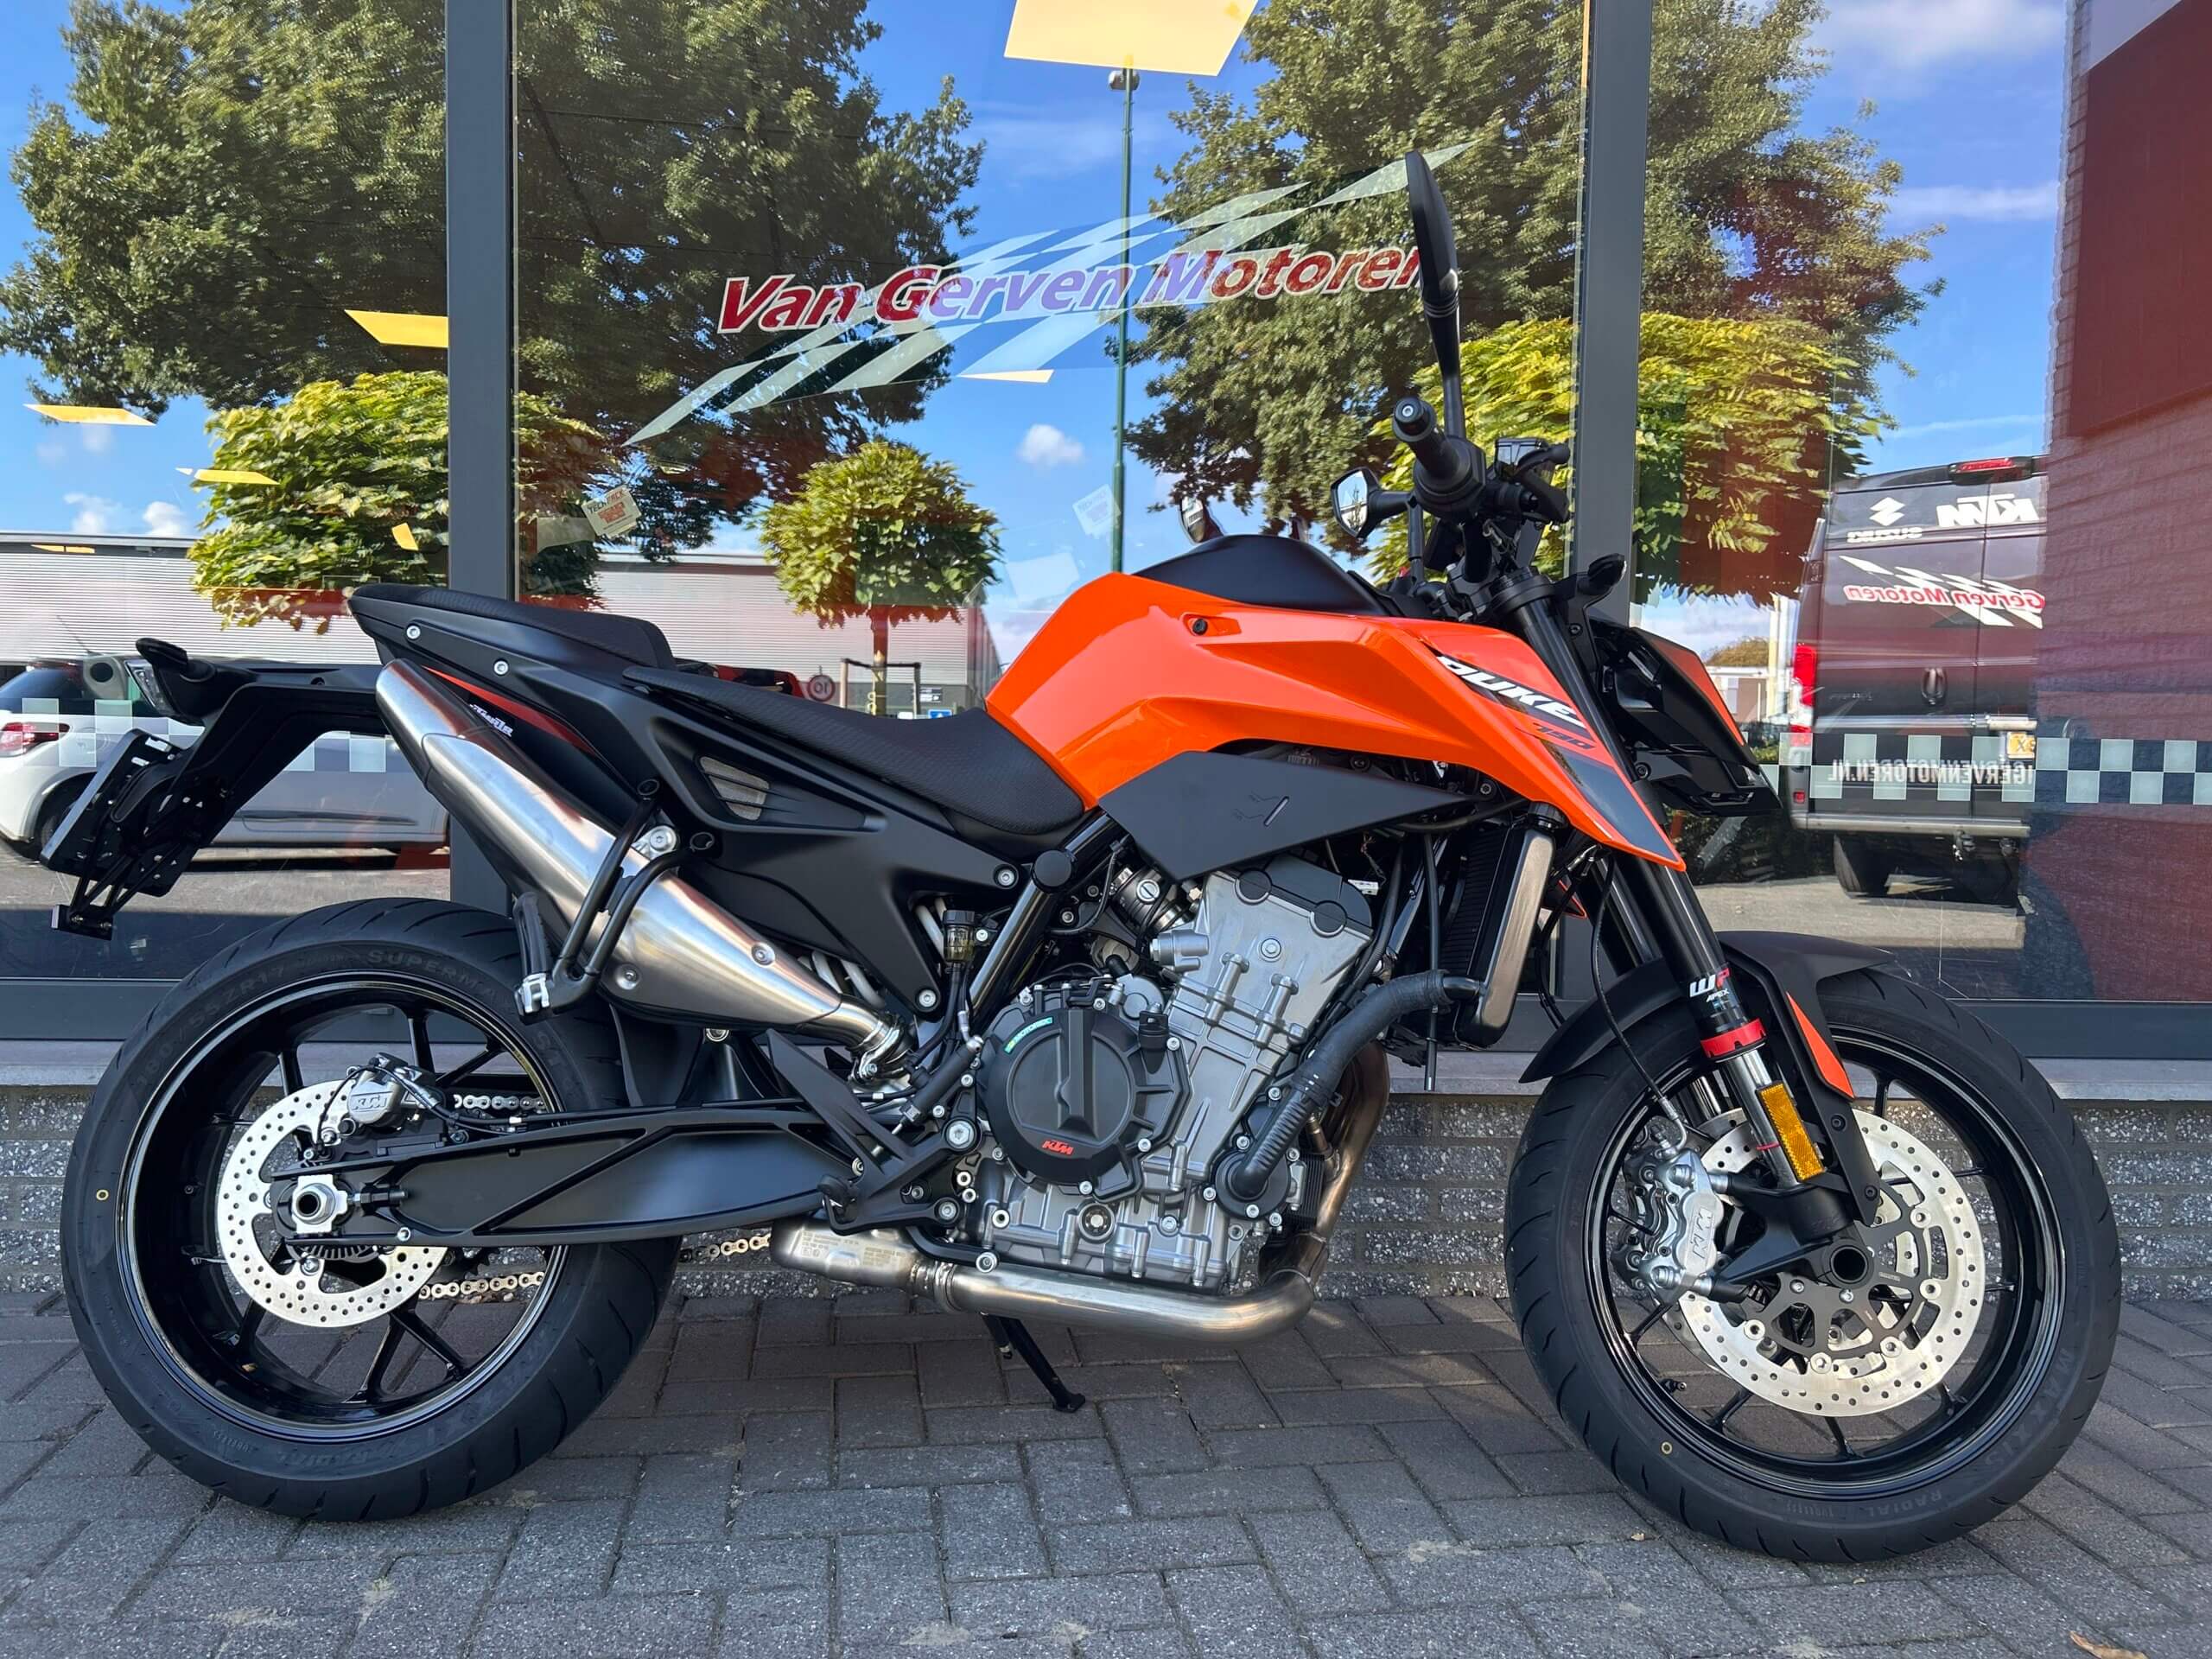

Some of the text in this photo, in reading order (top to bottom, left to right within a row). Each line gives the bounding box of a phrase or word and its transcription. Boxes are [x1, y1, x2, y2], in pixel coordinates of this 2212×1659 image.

[717, 274, 864, 334] Van
[874, 264, 1135, 324] Gerven
[1436, 655, 1587, 729] DUKE
[1689, 967, 1730, 998] WP
[1705, 988, 1730, 1002] APEX
[351, 1094, 388, 1112] KTM
[1041, 1139, 1074, 1155] KTM
[1691, 1207, 1713, 1259] KTM
[1865, 1489, 1943, 1518] RADIAL
